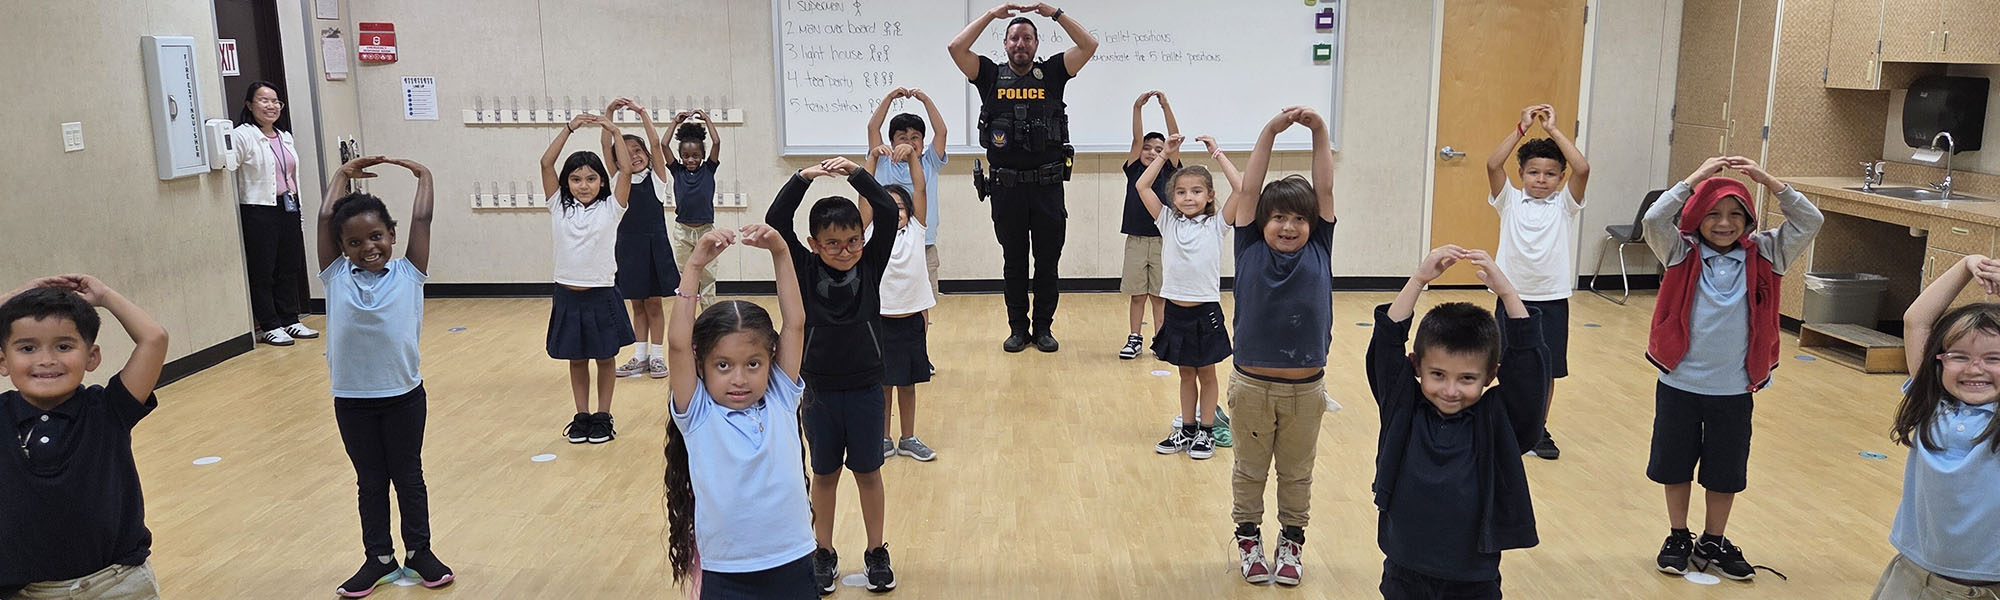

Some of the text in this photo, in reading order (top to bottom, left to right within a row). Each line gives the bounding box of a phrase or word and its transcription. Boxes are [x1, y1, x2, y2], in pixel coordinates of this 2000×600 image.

[785, 20, 794, 35] 2
[847, 20, 876, 34] board
[1104, 30, 1130, 43] ballet
[219, 43, 236, 71] XIT
[785, 43, 863, 66] 3 light house
[1149, 51, 1158, 62] 5
[787, 71, 798, 88] 4
[997, 88, 1046, 100] POLICE
[790, 97, 801, 113] 5
